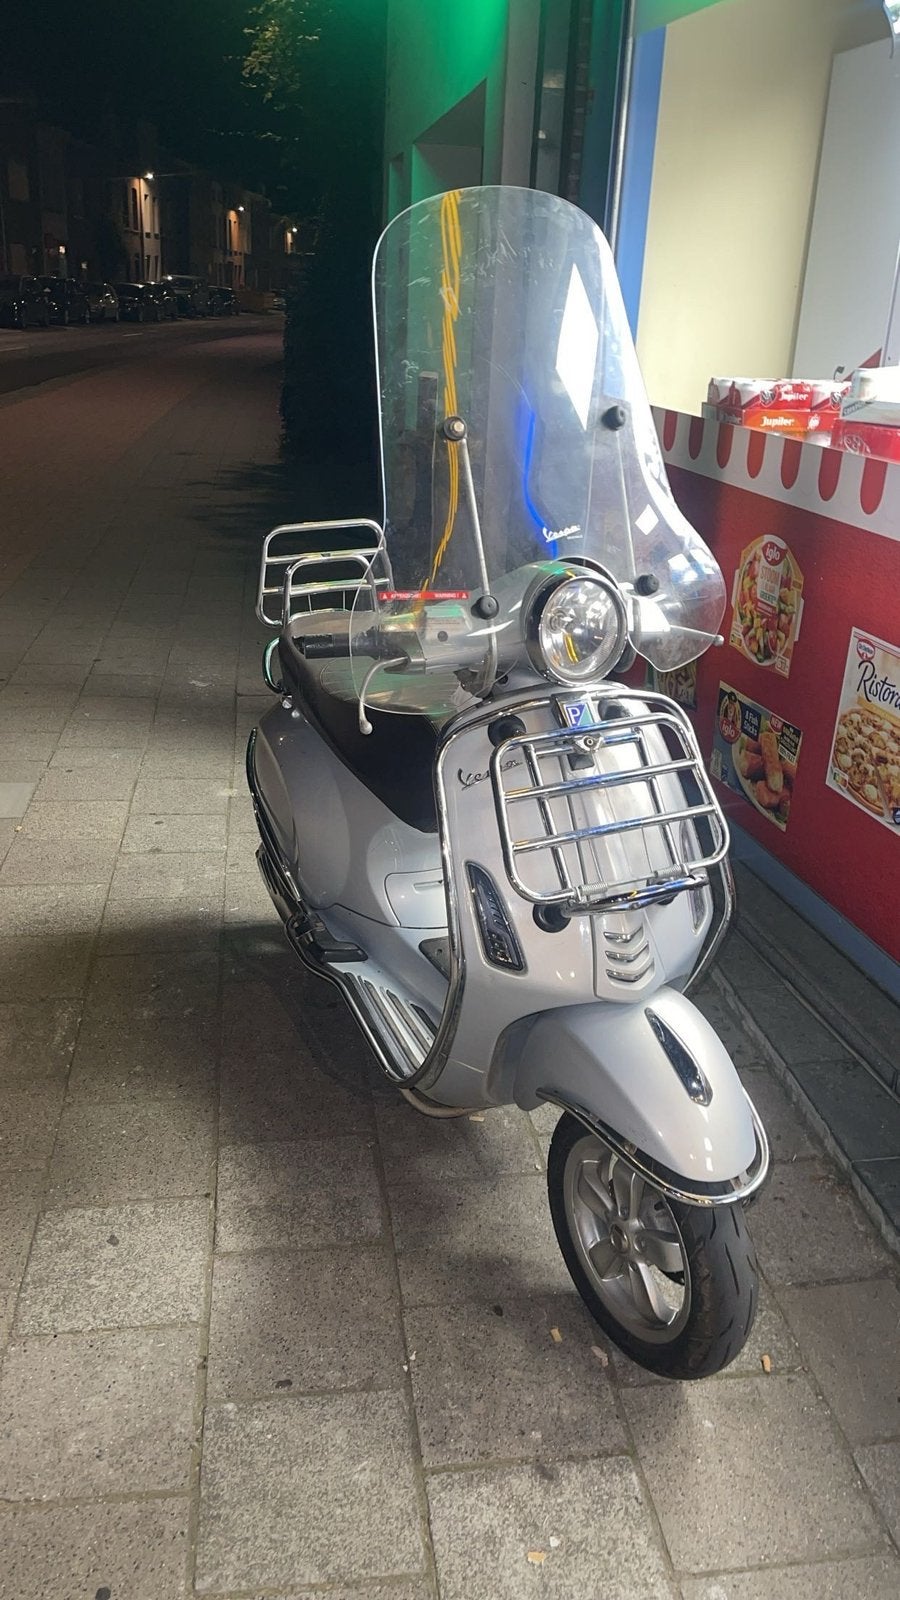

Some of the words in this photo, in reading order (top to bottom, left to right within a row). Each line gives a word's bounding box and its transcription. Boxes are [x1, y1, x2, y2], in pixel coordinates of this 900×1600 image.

[760, 415, 794, 428] Jupiler
[542, 525, 581, 543] Vespa
[766, 545, 780, 561] iglo
[567, 707, 580, 724] P
[722, 720, 735, 737] iglo
